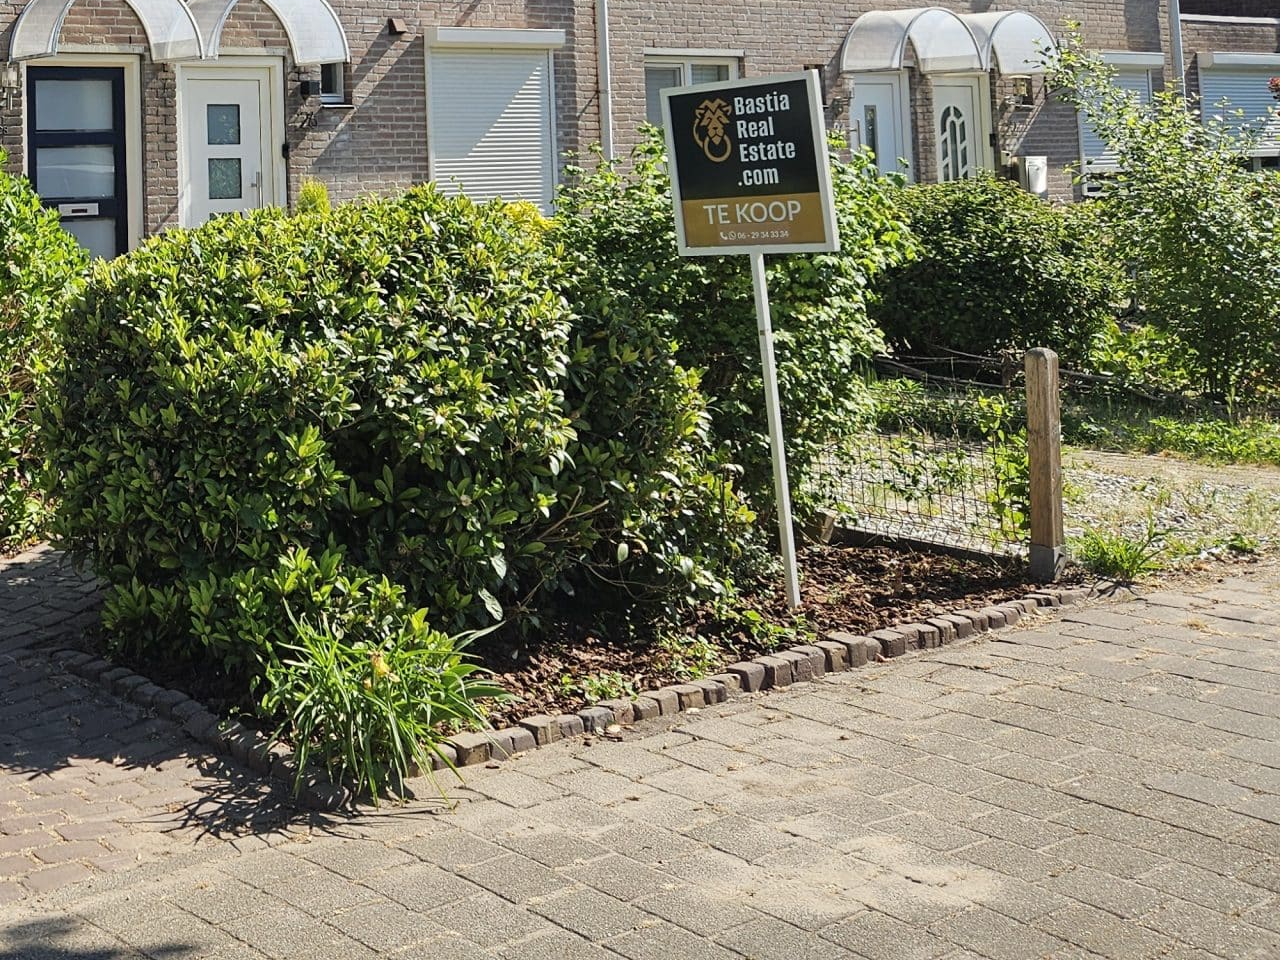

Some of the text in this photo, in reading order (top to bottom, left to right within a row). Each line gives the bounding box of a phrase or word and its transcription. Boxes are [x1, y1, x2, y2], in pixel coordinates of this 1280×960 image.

[734, 91, 789, 115] Bastia
[736, 116, 774, 139] Real
[739, 141, 796, 162] Estate
[738, 167, 779, 186] .com
[703, 200, 801, 224] TE KOOP
